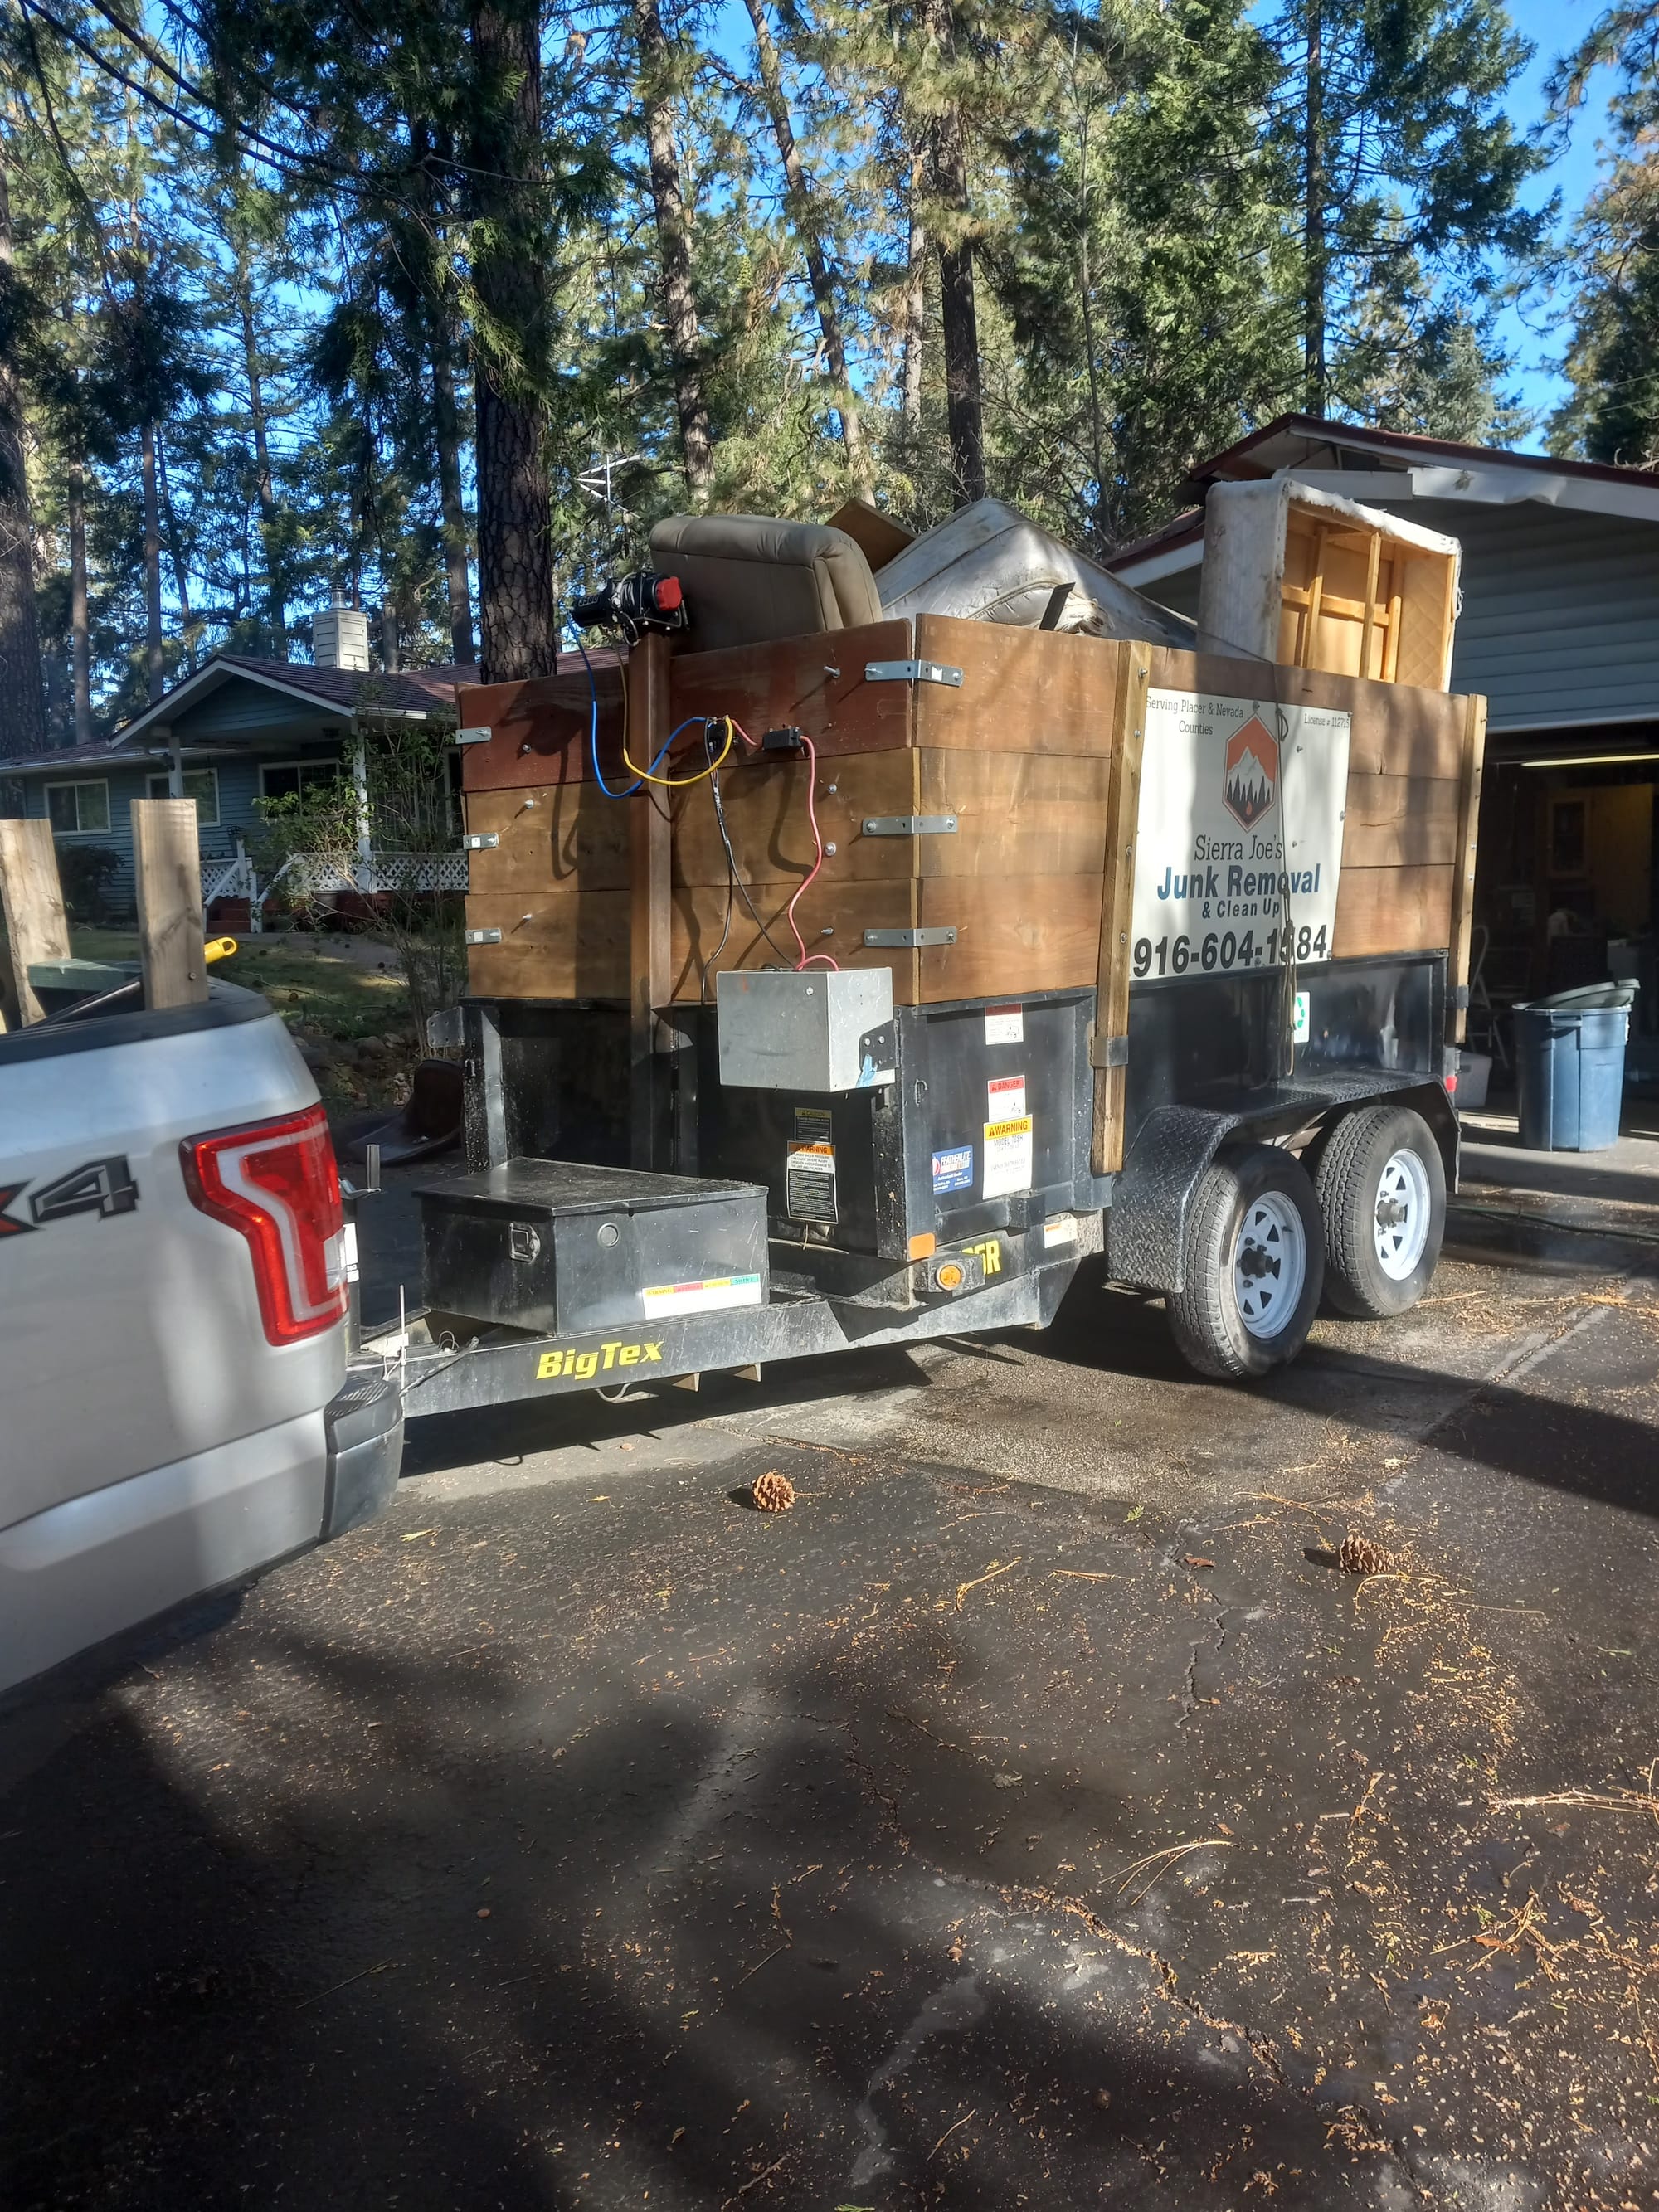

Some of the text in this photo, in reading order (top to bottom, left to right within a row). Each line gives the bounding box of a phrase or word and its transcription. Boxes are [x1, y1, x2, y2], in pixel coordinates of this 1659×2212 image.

[1146, 696, 1243, 717] Serving Placer & Nevada
[1179, 720, 1213, 735] Counties
[1194, 834, 1283, 860] Sierra Joe's
[1157, 863, 1321, 900] Junk Removal
[1202, 898, 1280, 919] & Clean Up
[998, 1080, 1019, 1090] DANGER
[995, 1121, 1028, 1136] WARNING
[801, 1144, 828, 1154] WARNING
[536, 1341, 664, 1379] BigTex
